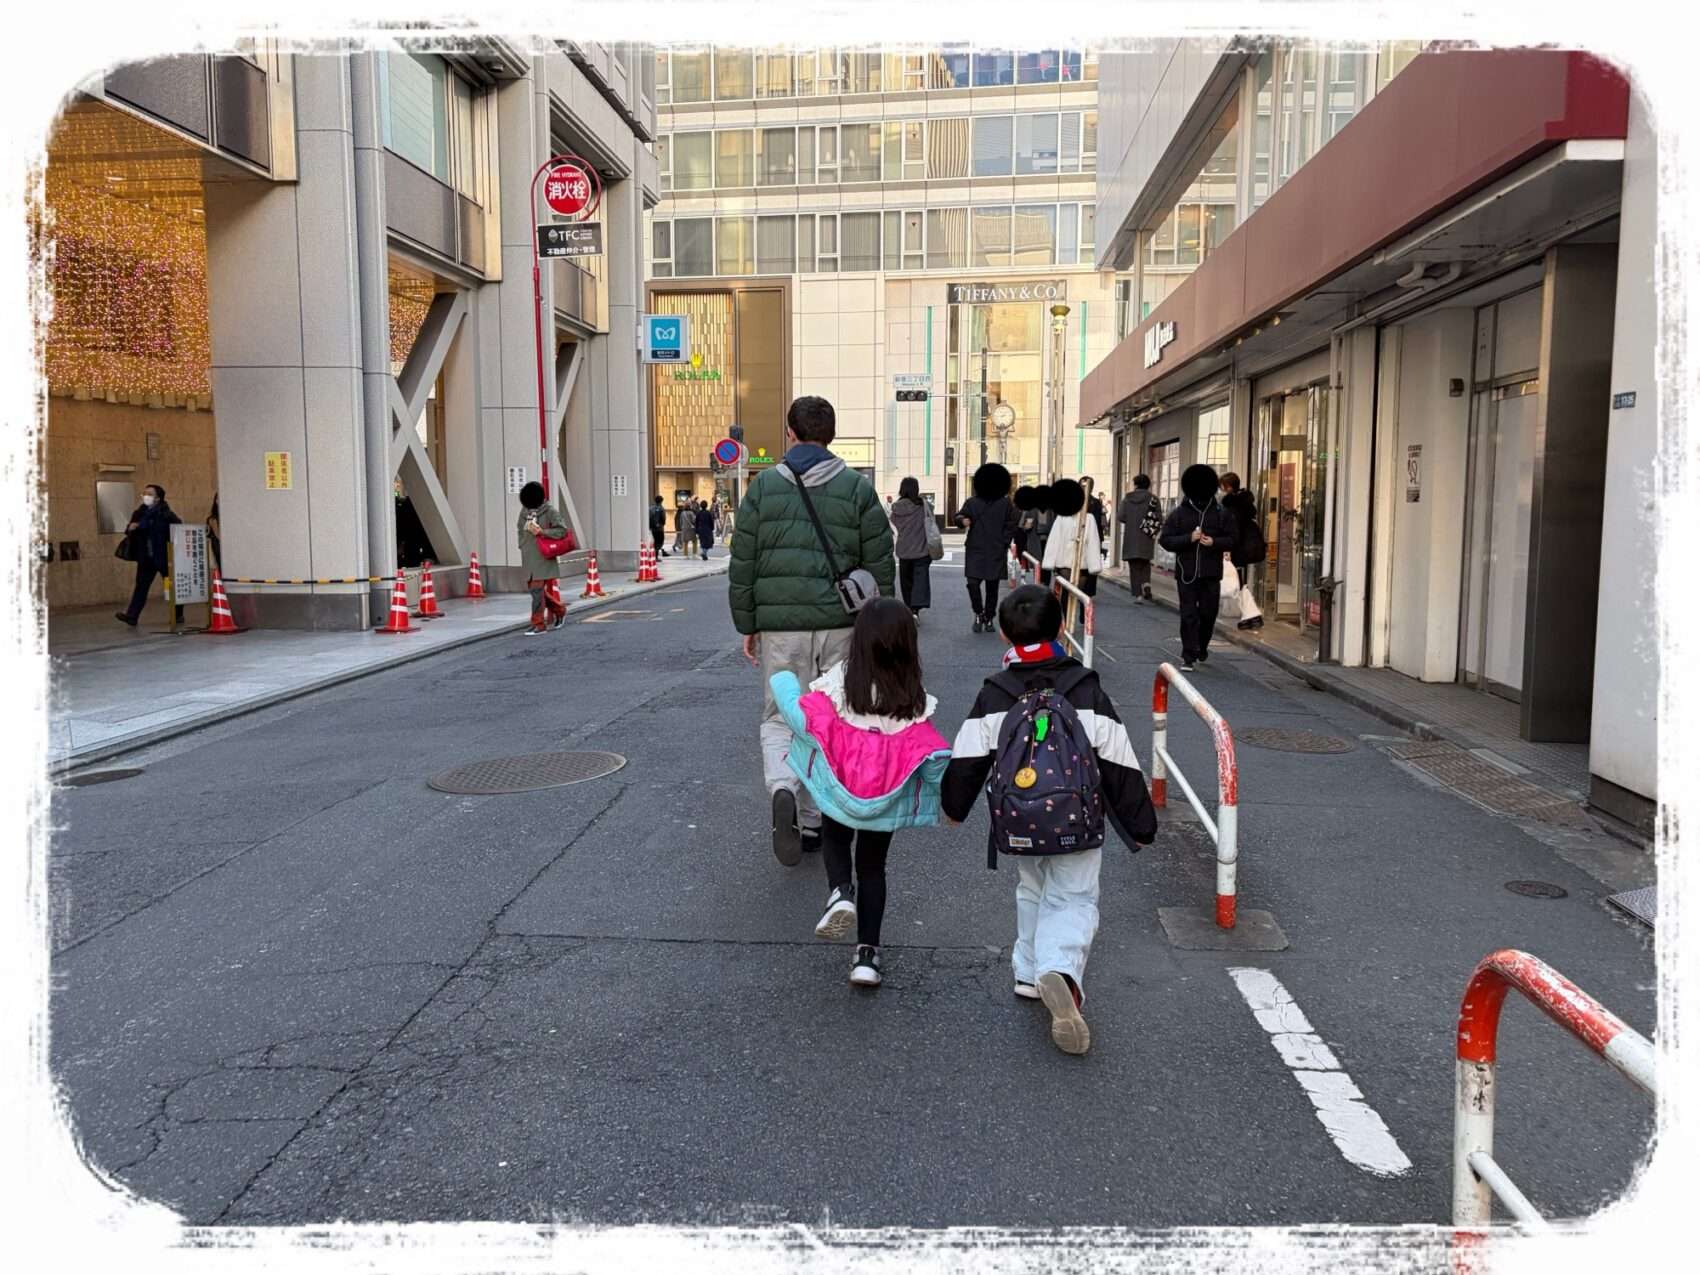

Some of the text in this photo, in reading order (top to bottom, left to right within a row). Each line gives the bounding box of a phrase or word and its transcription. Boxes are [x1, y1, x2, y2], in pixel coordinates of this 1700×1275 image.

[548, 181, 587, 200] 消火栓
[559, 230, 580, 241] TFC
[954, 286, 1017, 301] TIFFANY
